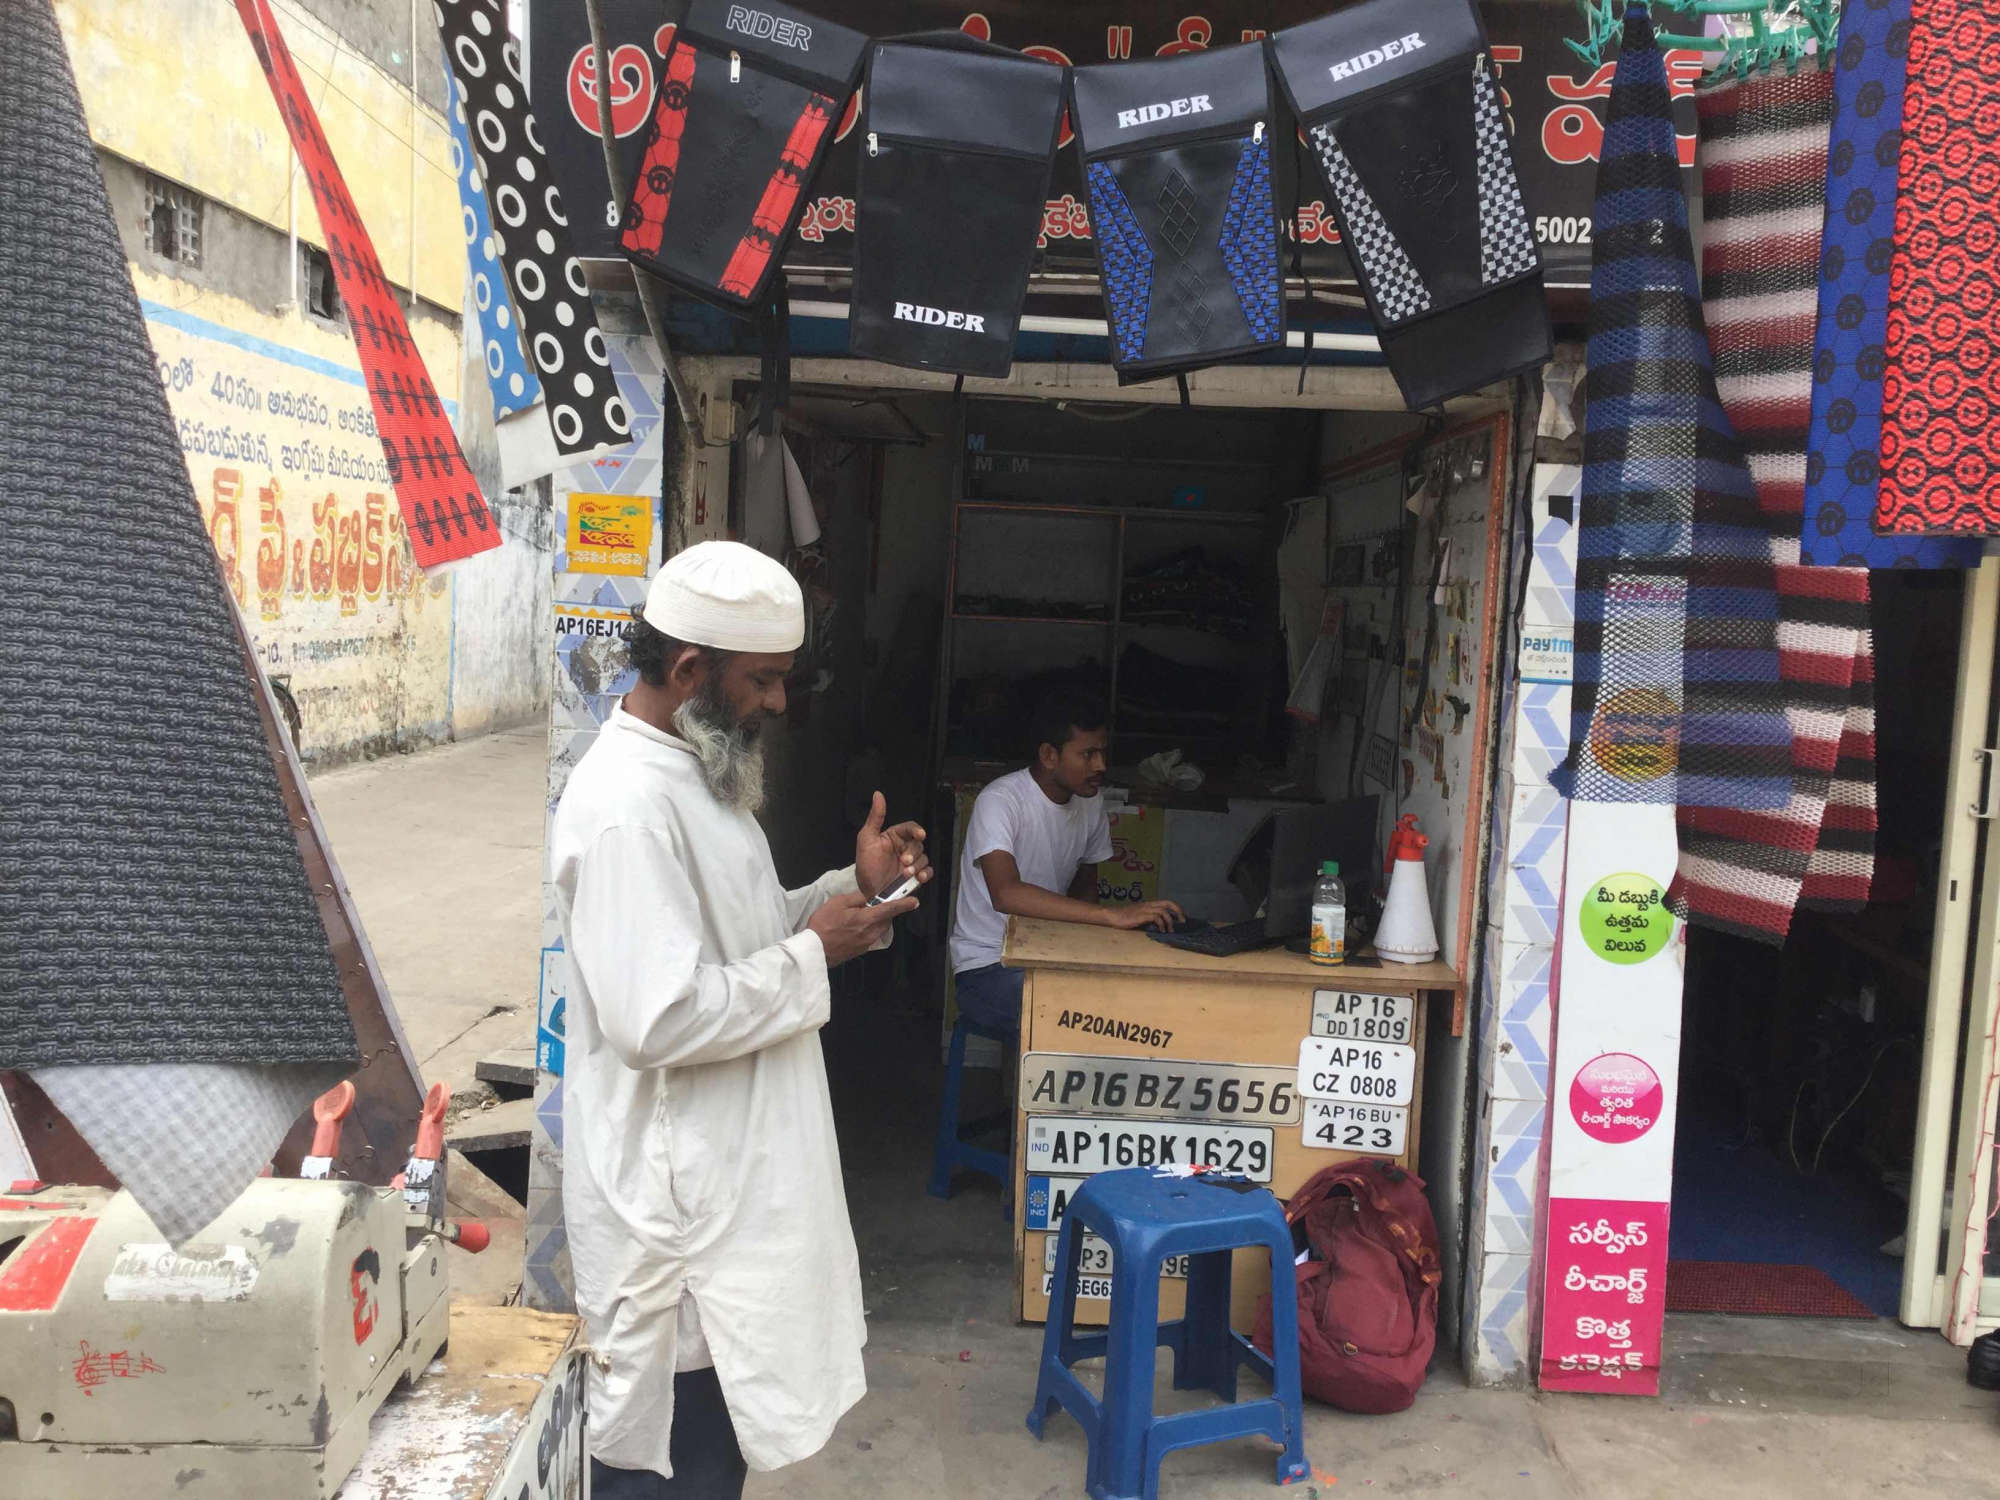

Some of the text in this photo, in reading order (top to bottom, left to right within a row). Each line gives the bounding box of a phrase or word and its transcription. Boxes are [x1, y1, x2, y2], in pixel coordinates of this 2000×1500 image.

[727, 5, 812, 52] RIDER
[1328, 32, 1427, 82] RIDER
[1117, 93, 1214, 129] RIDER
[1535, 216, 1592, 244] 5002
[894, 301, 985, 334] RIDER
[338, 406, 380, 439] అంకిత
[179, 417, 274, 472] డపబడుతున్న
[555, 616, 637, 638] AP16EJ14
[1597, 887, 1661, 912] మీ డబ్బుకి
[1604, 915, 1650, 932] ఉత్తమ
[1604, 938, 1647, 953] విలువ
[1058, 1009, 1174, 1049] AP20AN2967
[1313, 1072, 1397, 1098] CZ 0808
[1031, 1143, 1049, 1153] IND
[1030, 1208, 1047, 1217] IND
[1568, 1218, 1648, 1254] సర్వీస్
[1564, 1264, 1648, 1304] రీచార్జ్
[1576, 1316, 1633, 1349] కొత్త
